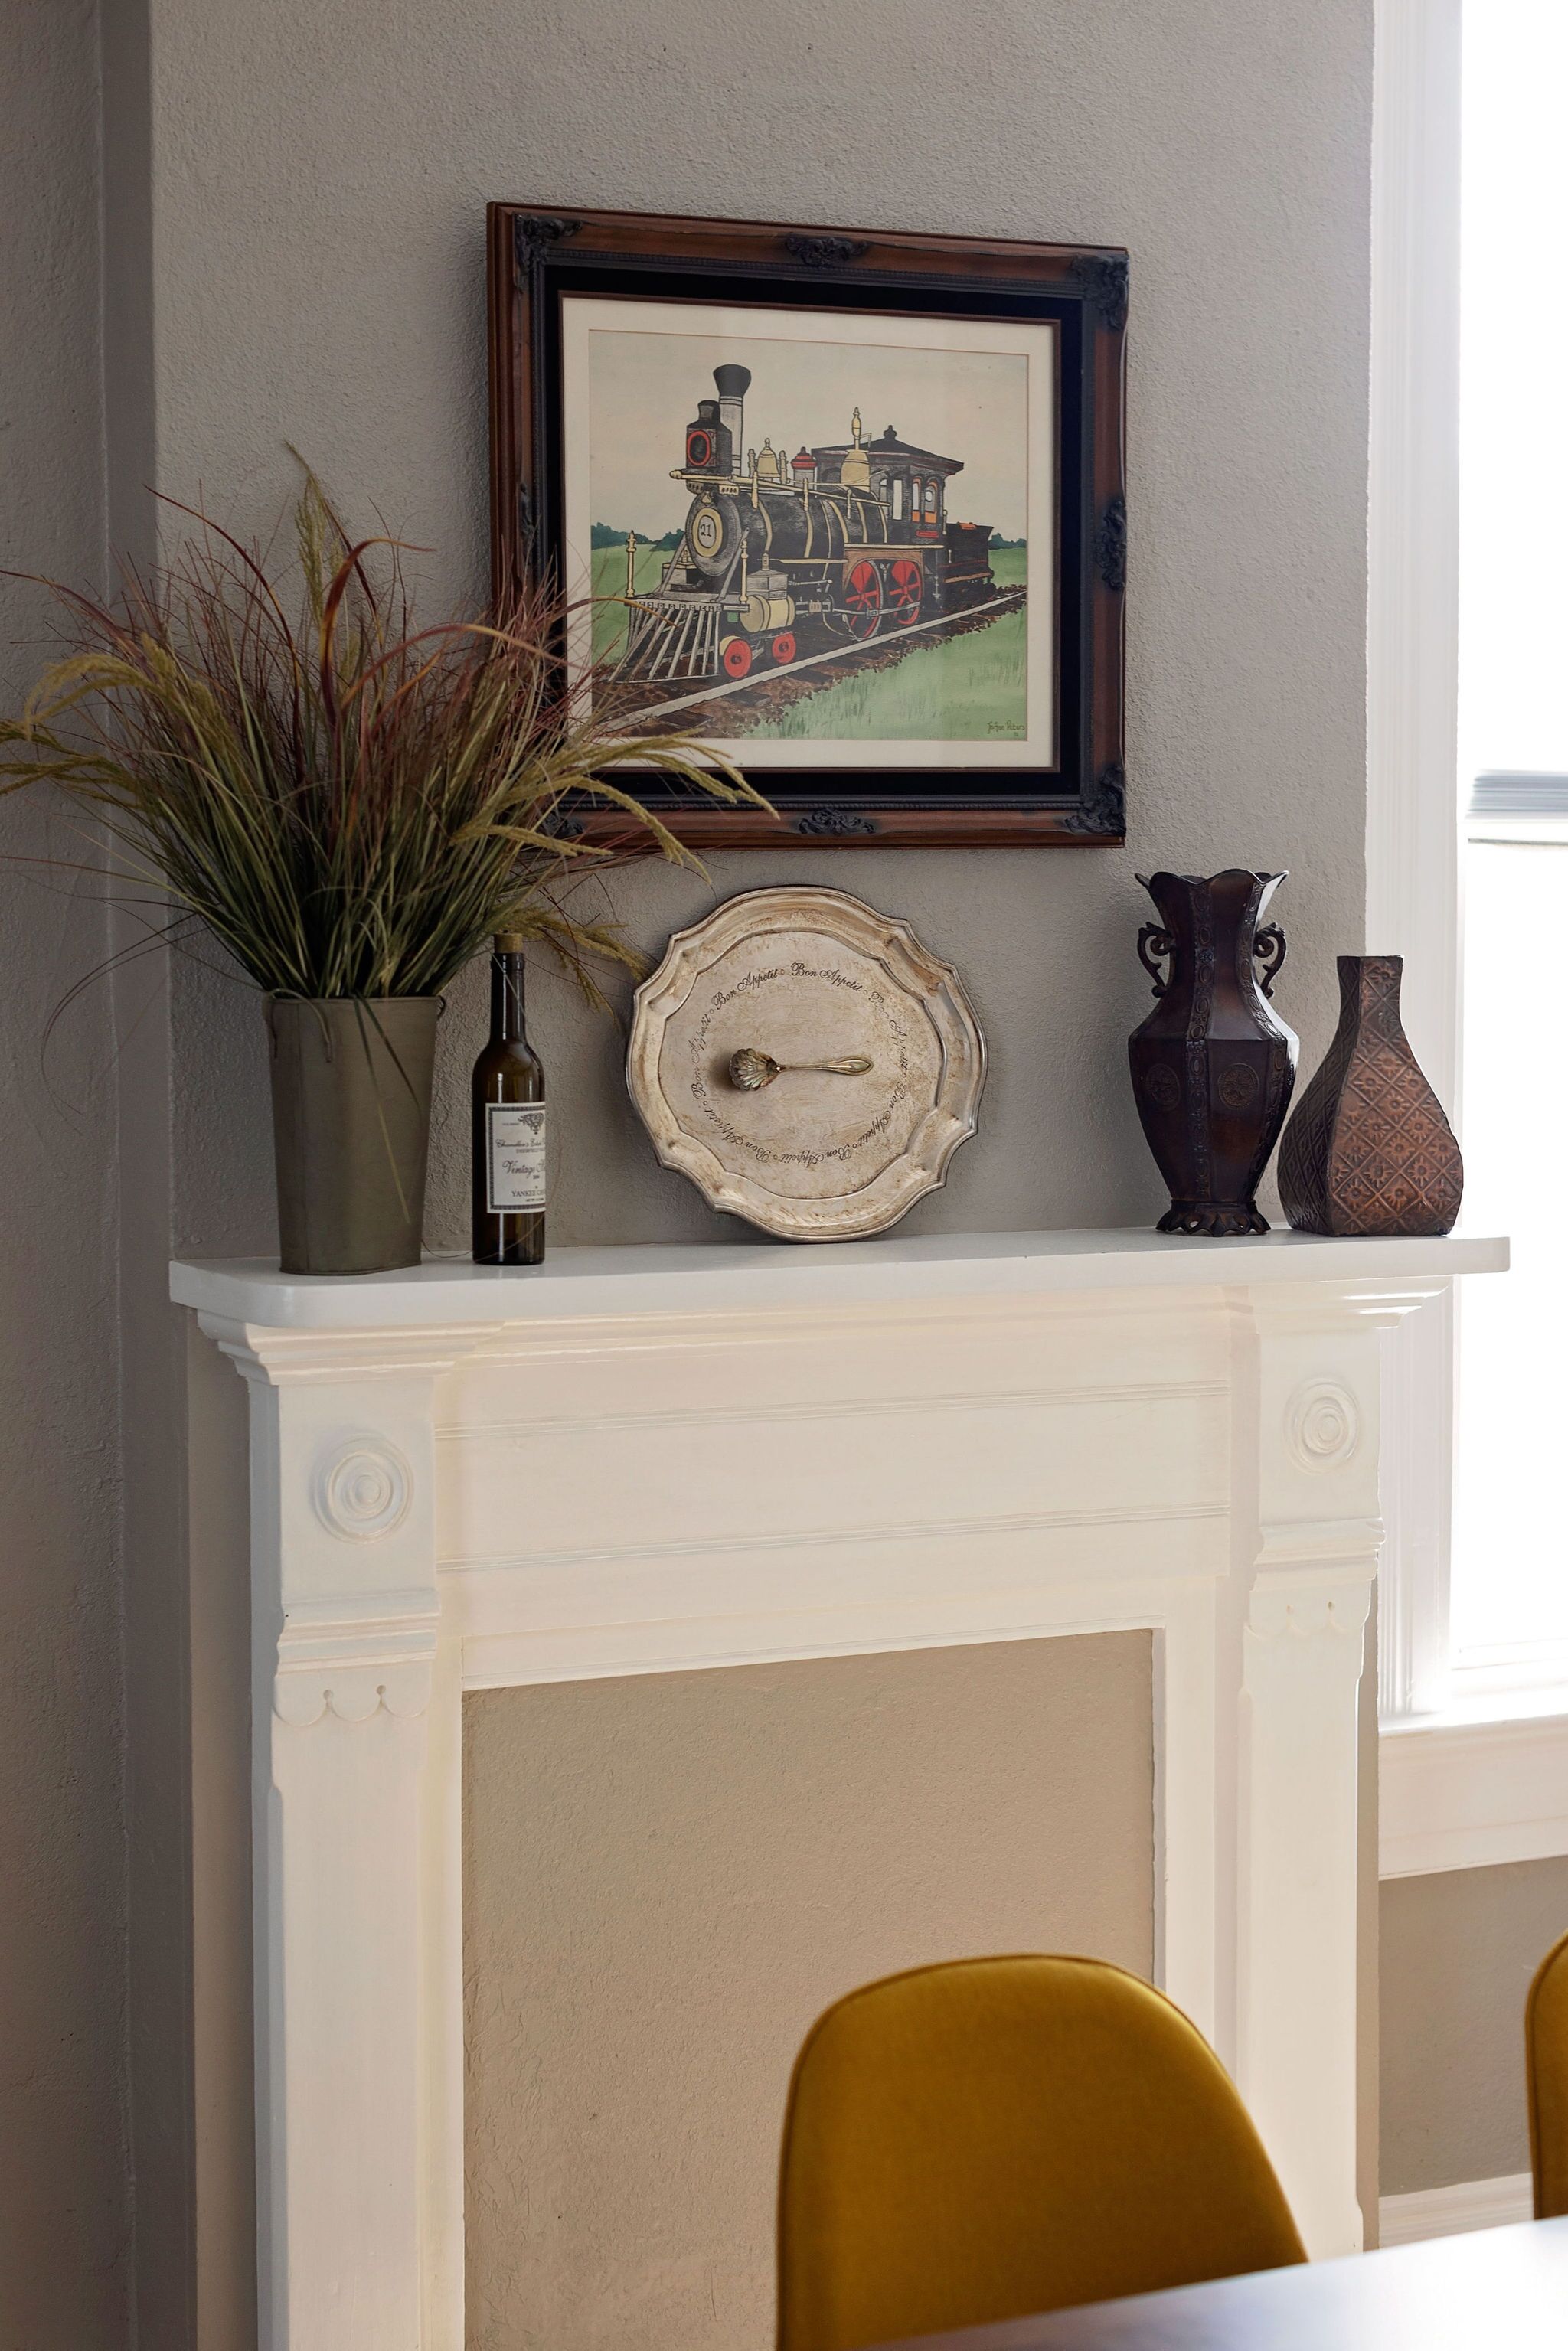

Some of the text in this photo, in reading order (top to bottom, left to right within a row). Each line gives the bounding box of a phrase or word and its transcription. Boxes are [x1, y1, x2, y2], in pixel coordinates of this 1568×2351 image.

[700, 524, 712, 537] 21
[711, 968, 779, 1010] Bon Appetit
[790, 962, 864, 992] Bon Appetit
[691, 1066, 706, 1099] Bon
[858, 1081, 907, 1147] Bon Appetit
[704, 1108, 772, 1163] Bon Appetit
[779, 1144, 852, 1168] Bon Appetit
